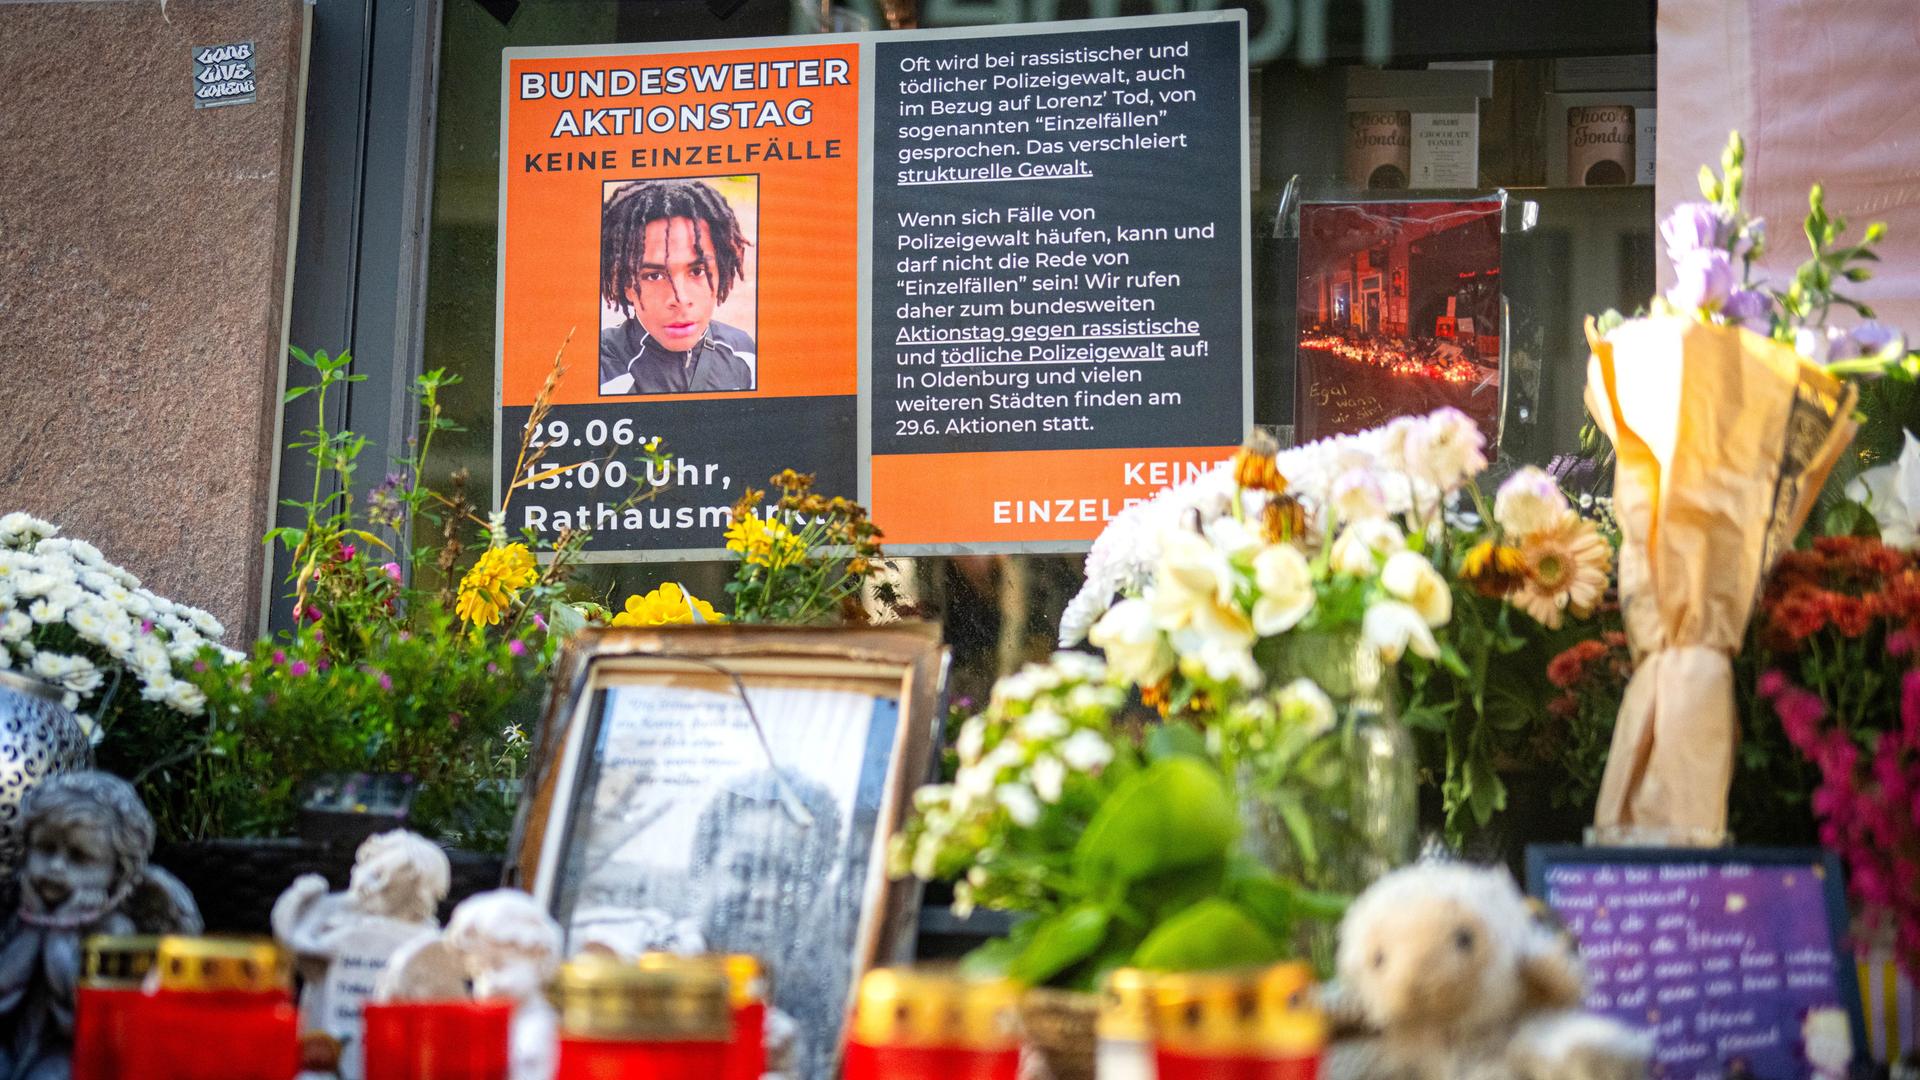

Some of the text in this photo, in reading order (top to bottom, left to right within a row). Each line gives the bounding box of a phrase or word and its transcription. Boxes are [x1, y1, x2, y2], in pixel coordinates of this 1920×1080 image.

[900, 41, 1189, 73] Oft wird bei rassistischer und
[520, 58, 851, 100] BUNDESWEITER
[898, 65, 1185, 95] tödlicher Polizeigewalt, auch
[899, 101, 924, 117] im
[931, 101, 993, 116] Bezug
[998, 95, 1032, 112] auf
[1111, 89, 1154, 107] Tod,
[1158, 90, 1196, 103] von
[551, 99, 812, 138] AKTIONSTAG
[898, 121, 1030, 142] sogenannten
[526, 138, 841, 173] KEINE EINZELFÄLLE
[898, 133, 1188, 165] gesprochen. Das verschleiert
[896, 159, 1094, 186] strukturelle Gewalt.
[897, 206, 1096, 228] Wenn sich Fälle von
[897, 222, 1215, 252] Polizeigewalt häufen, kann und
[896, 251, 1129, 273] darf nicht die Rede von
[1032, 274, 1079, 292] sein!
[1084, 272, 1121, 290] Wir
[1126, 271, 1181, 289] rufen
[896, 296, 1155, 319] daher zum bundesweiten
[895, 318, 1201, 346] Aktionstag gegen rassistische
[896, 340, 1209, 368] und tödliche Polizeigewalt auf!
[896, 367, 1142, 389] In Oldenburg und vielen
[895, 390, 1182, 412] weiteren Städten finden am
[1309, 382, 1347, 405] Egal
[895, 416, 1095, 436] 29.6. Aktionen statt.
[646, 458, 731, 490] Uhr,
[1125, 461, 1224, 485] KEIN
